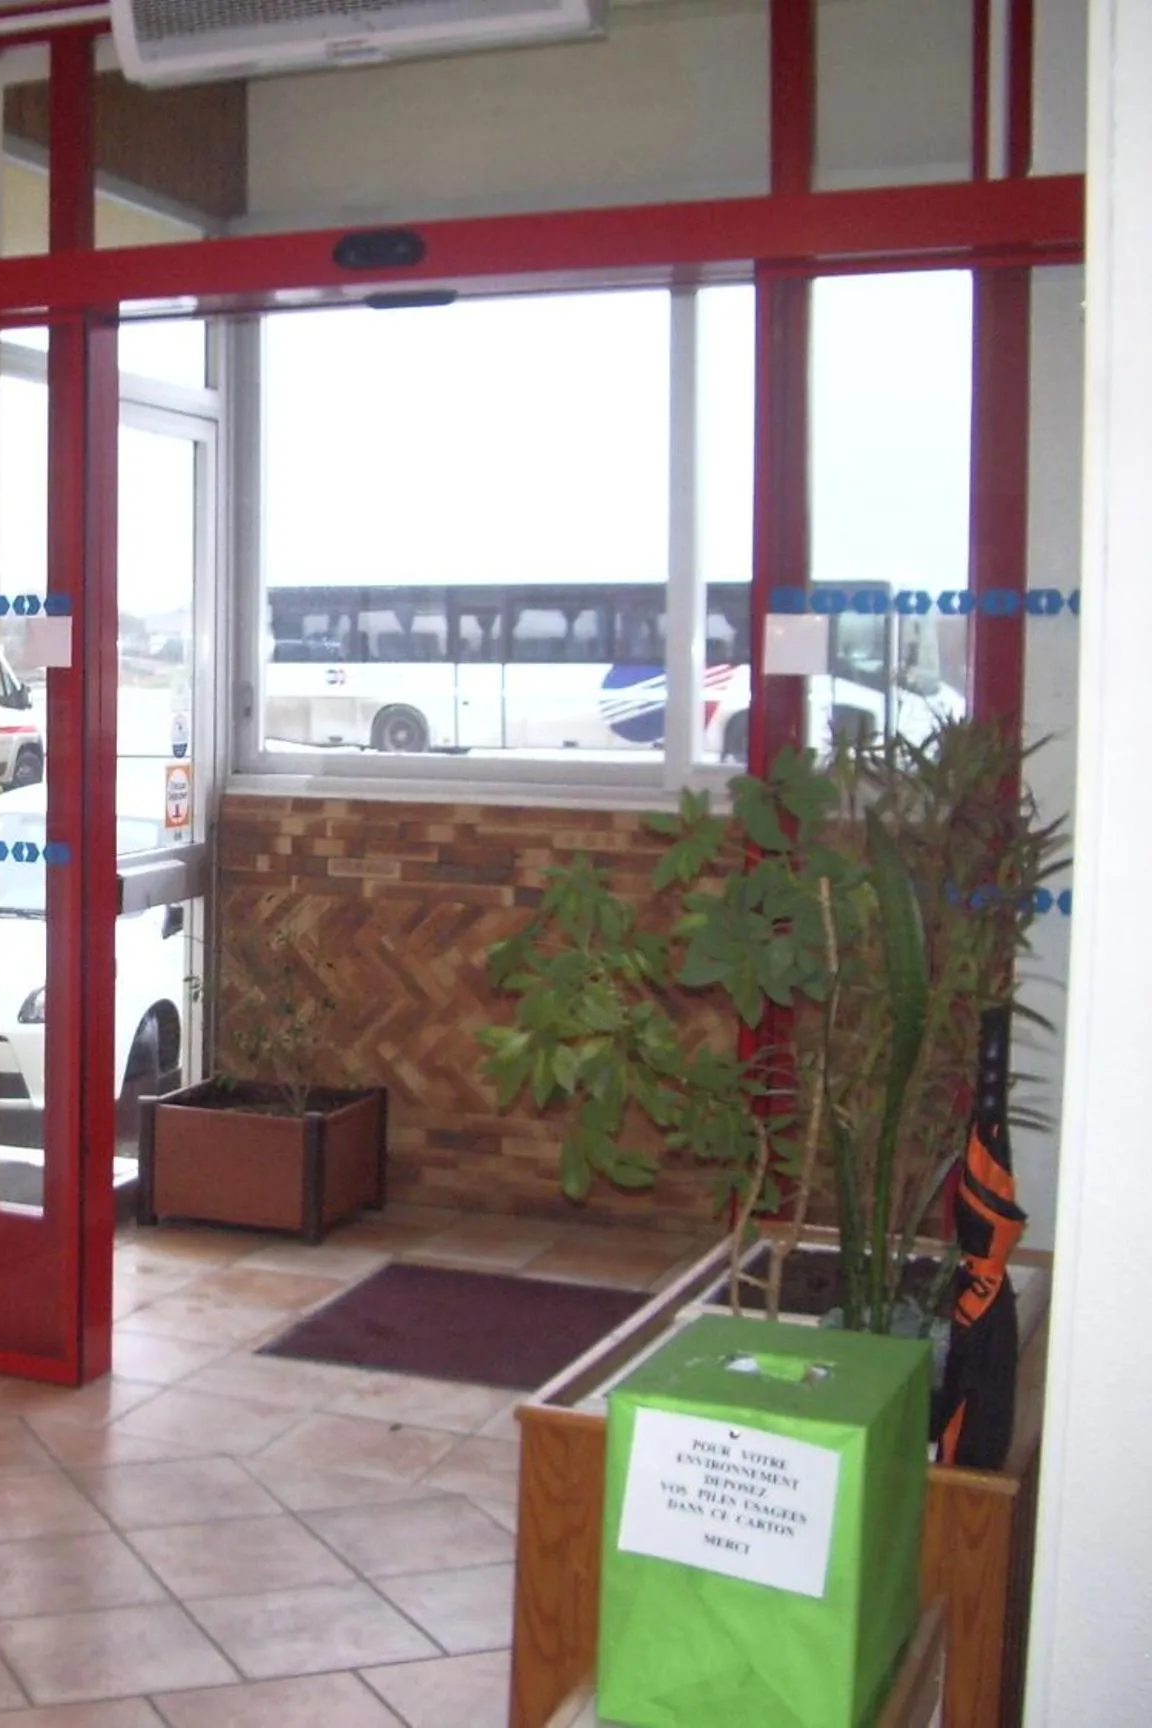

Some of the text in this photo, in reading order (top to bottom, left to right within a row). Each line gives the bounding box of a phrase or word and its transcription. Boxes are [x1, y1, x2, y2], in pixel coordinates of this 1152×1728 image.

[676, 1452, 799, 1491] ENVIRONNEMENT
[691, 1439, 787, 1470] POUR VOTRE
[660, 1480, 808, 1525] VOS PILES USAGEES
[703, 1474, 768, 1498] DEPOSEZ
[667, 1497, 796, 1537] DANS CE CARTON
[704, 1532, 751, 1555] MERCI
